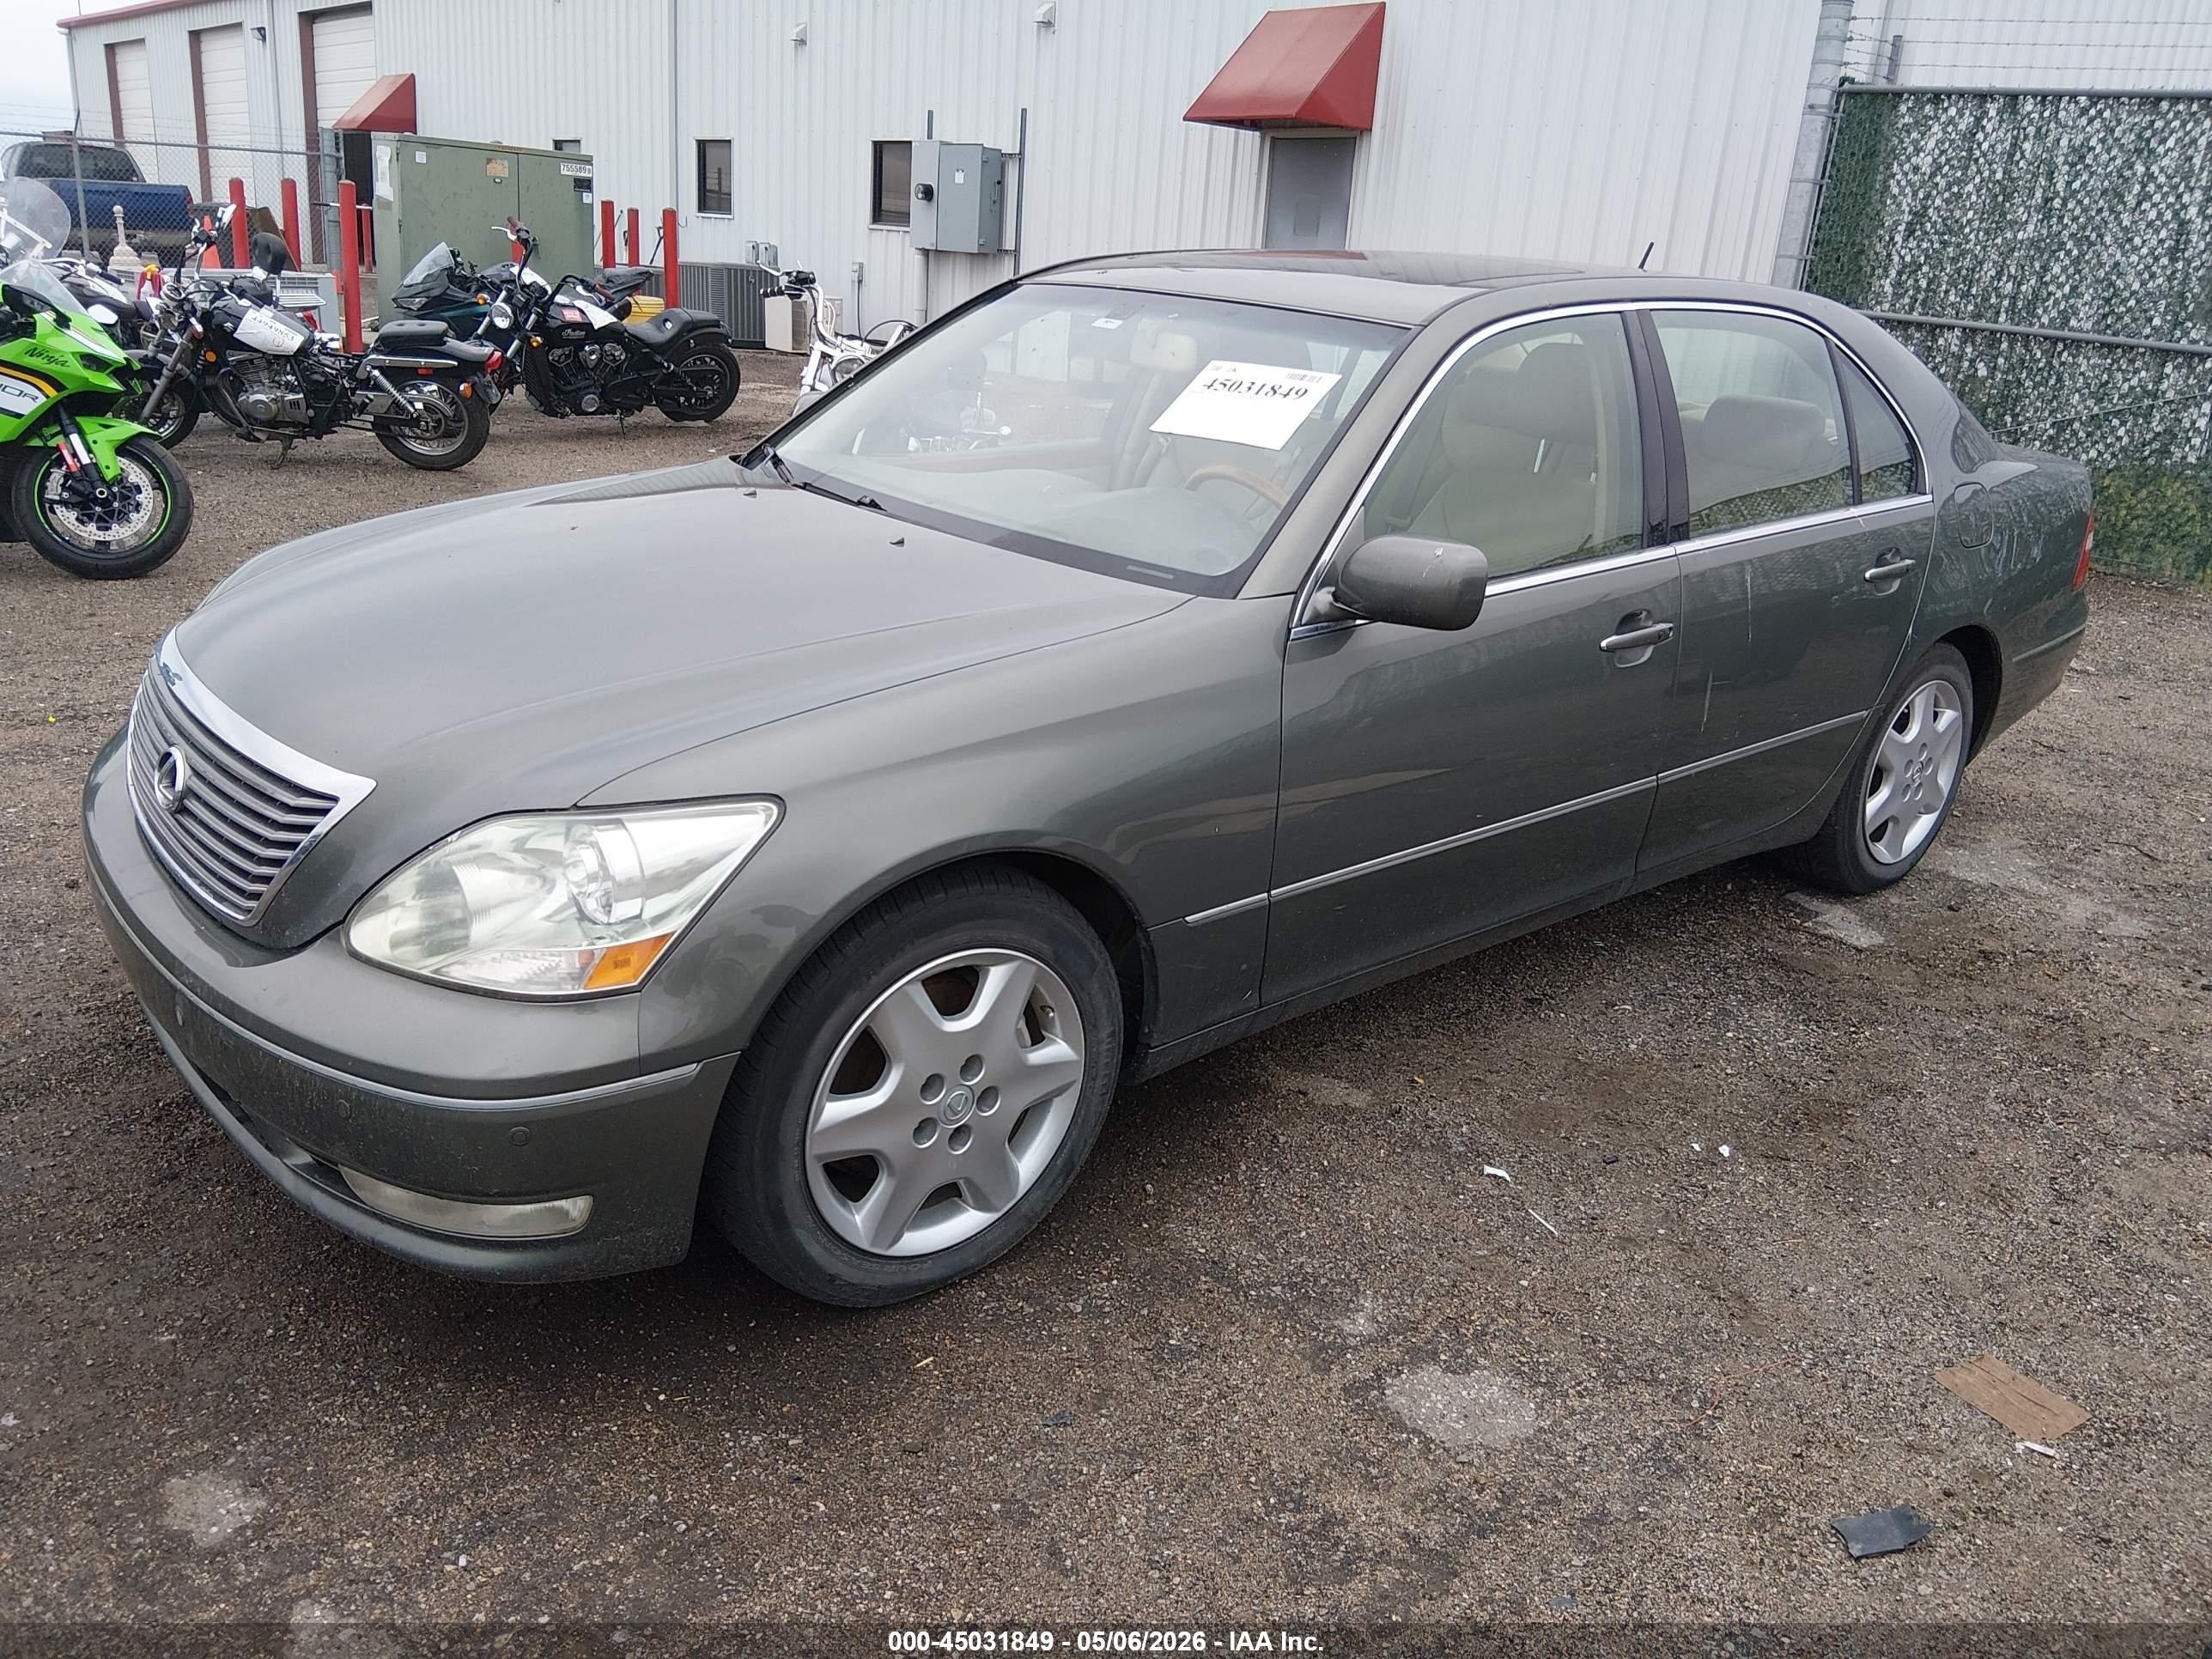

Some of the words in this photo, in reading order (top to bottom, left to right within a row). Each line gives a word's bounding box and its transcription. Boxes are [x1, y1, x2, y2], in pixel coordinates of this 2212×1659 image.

[562, 163, 586, 174] 755589
[24, 347, 70, 368] Ninja
[1203, 378, 1309, 400] 45031849
